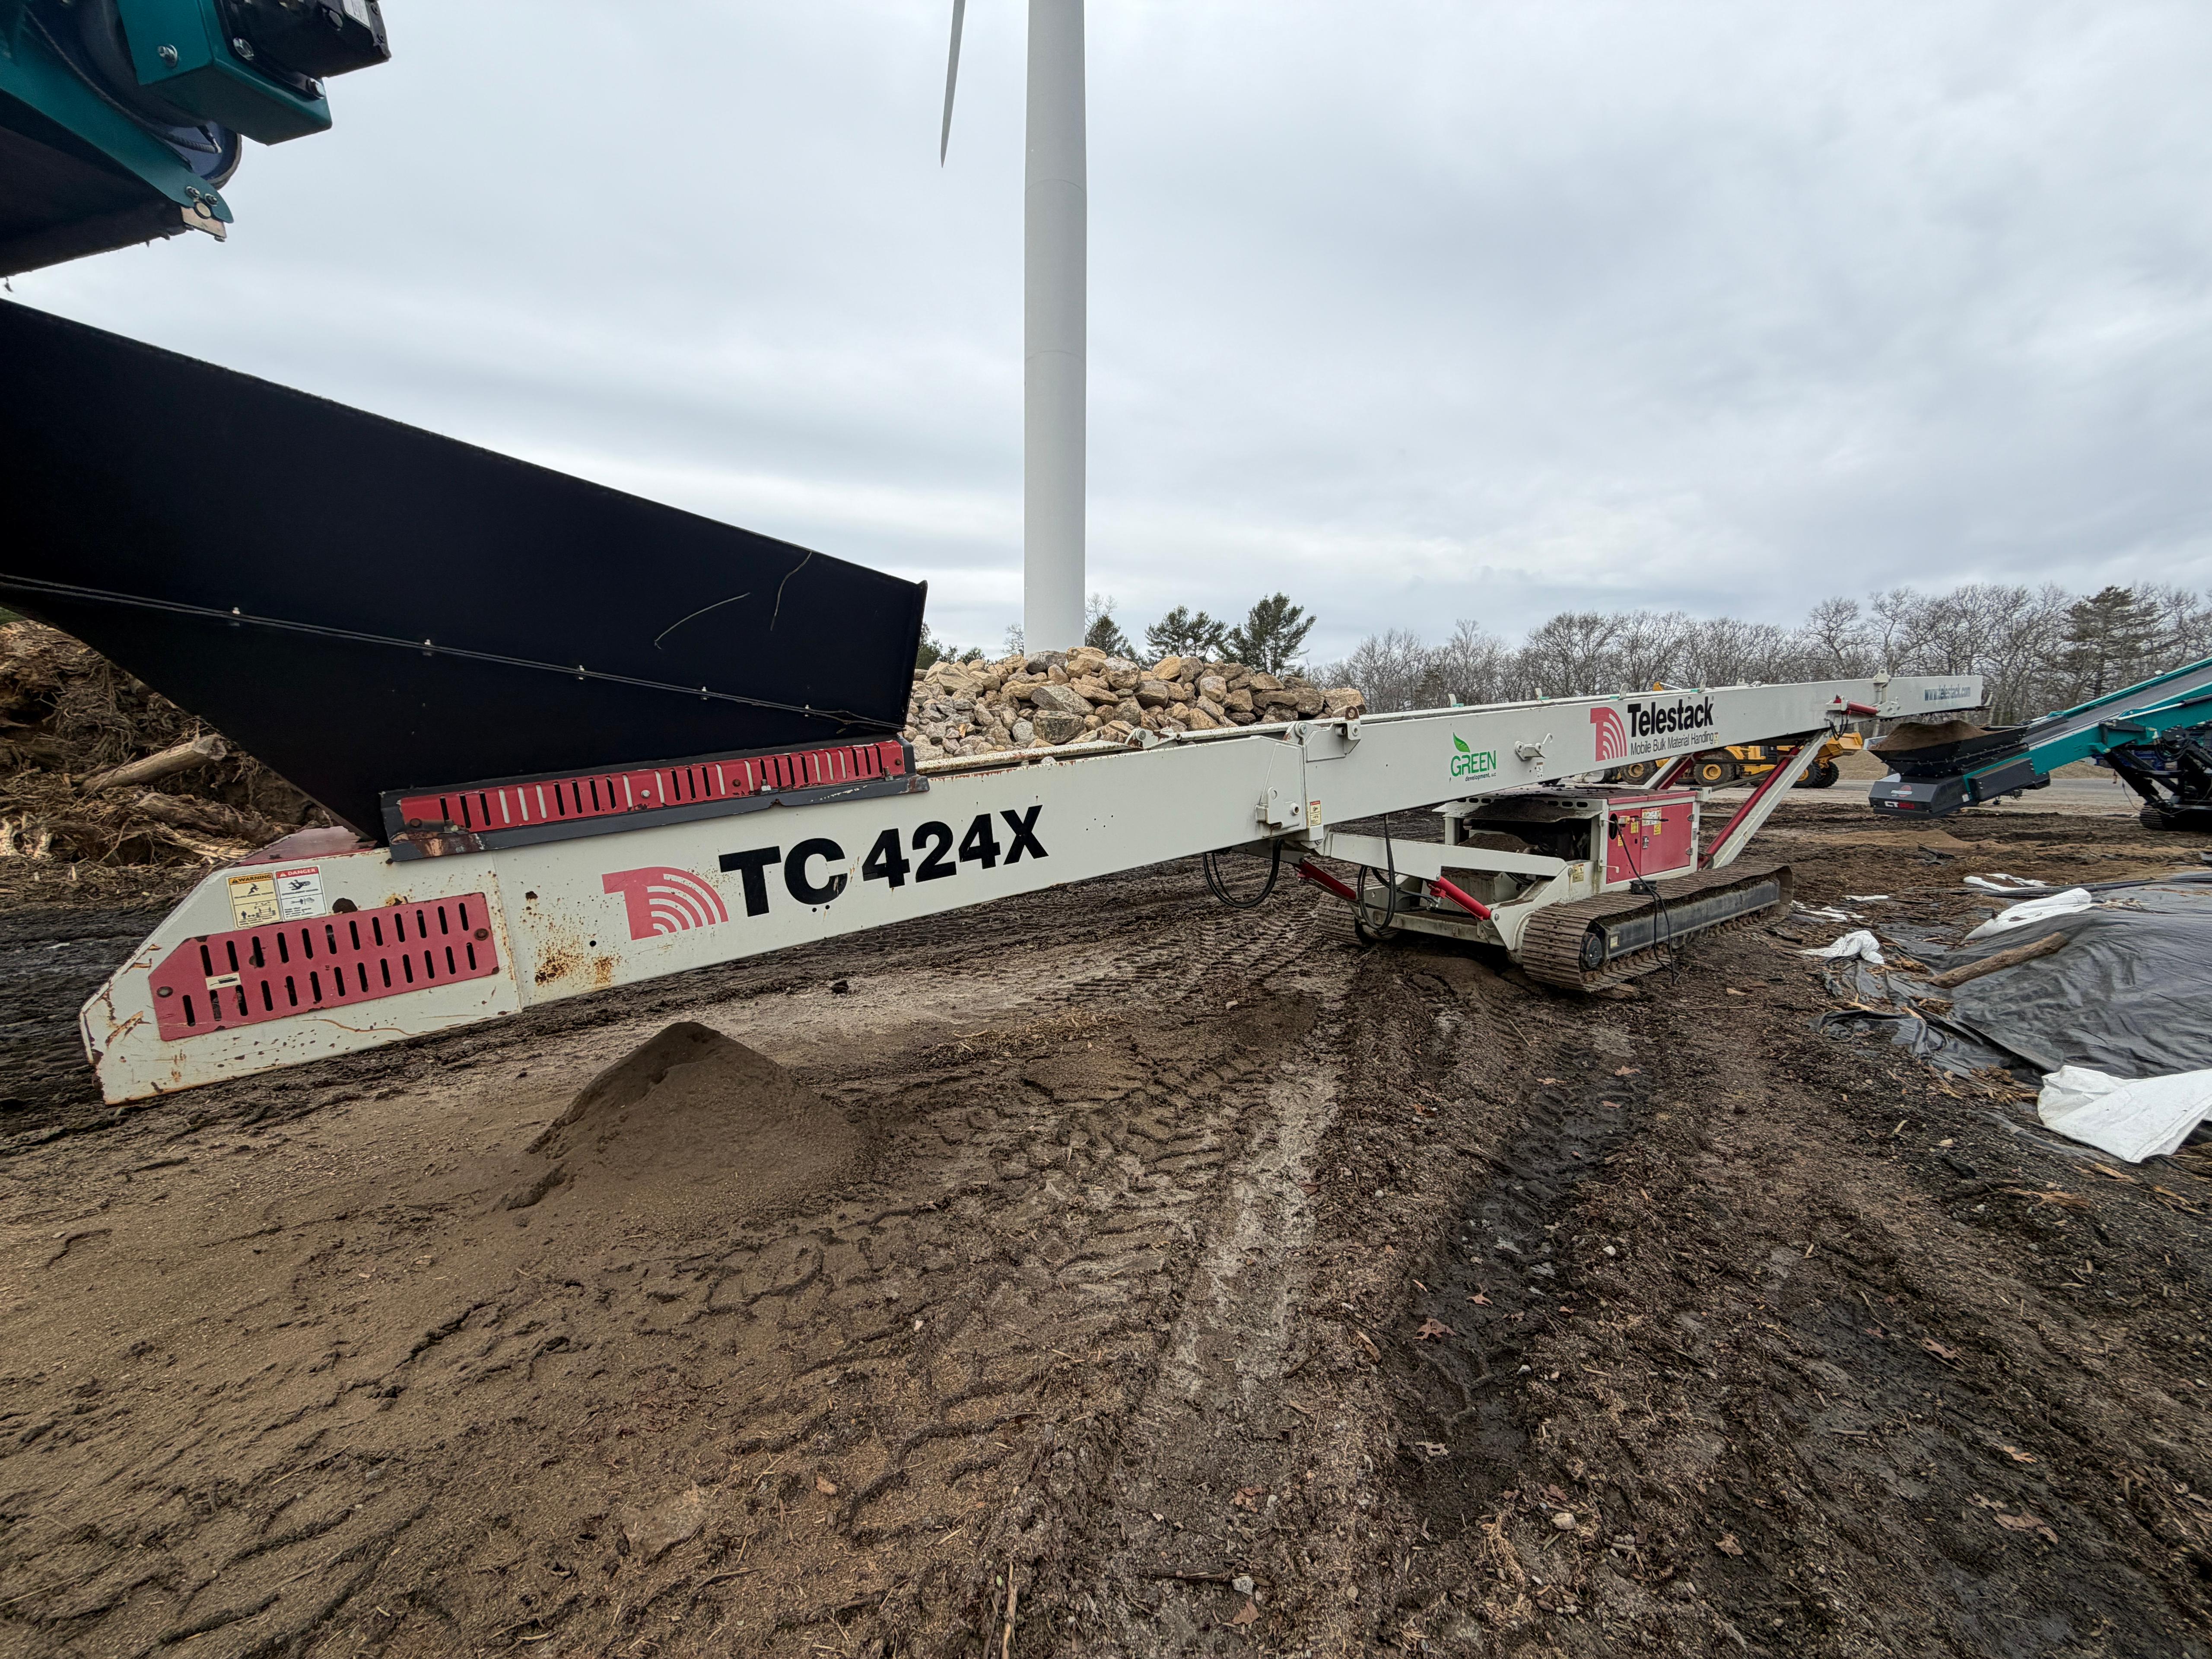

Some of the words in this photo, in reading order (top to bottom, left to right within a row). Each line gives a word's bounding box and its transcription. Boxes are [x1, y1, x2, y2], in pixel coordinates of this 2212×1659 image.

[1627, 696, 1714, 737] Telestack
[1630, 741, 1651, 756] Mobile
[1653, 737, 1666, 752] Bulk
[1668, 733, 1689, 750] Material
[1691, 731, 1714, 745] Handling
[1451, 750, 1496, 777] GREEN
[287, 868, 317, 876] DANGER
[718, 837, 848, 918] TC
[862, 804, 1049, 889] 424X
[238, 874, 272, 882] WARNING
